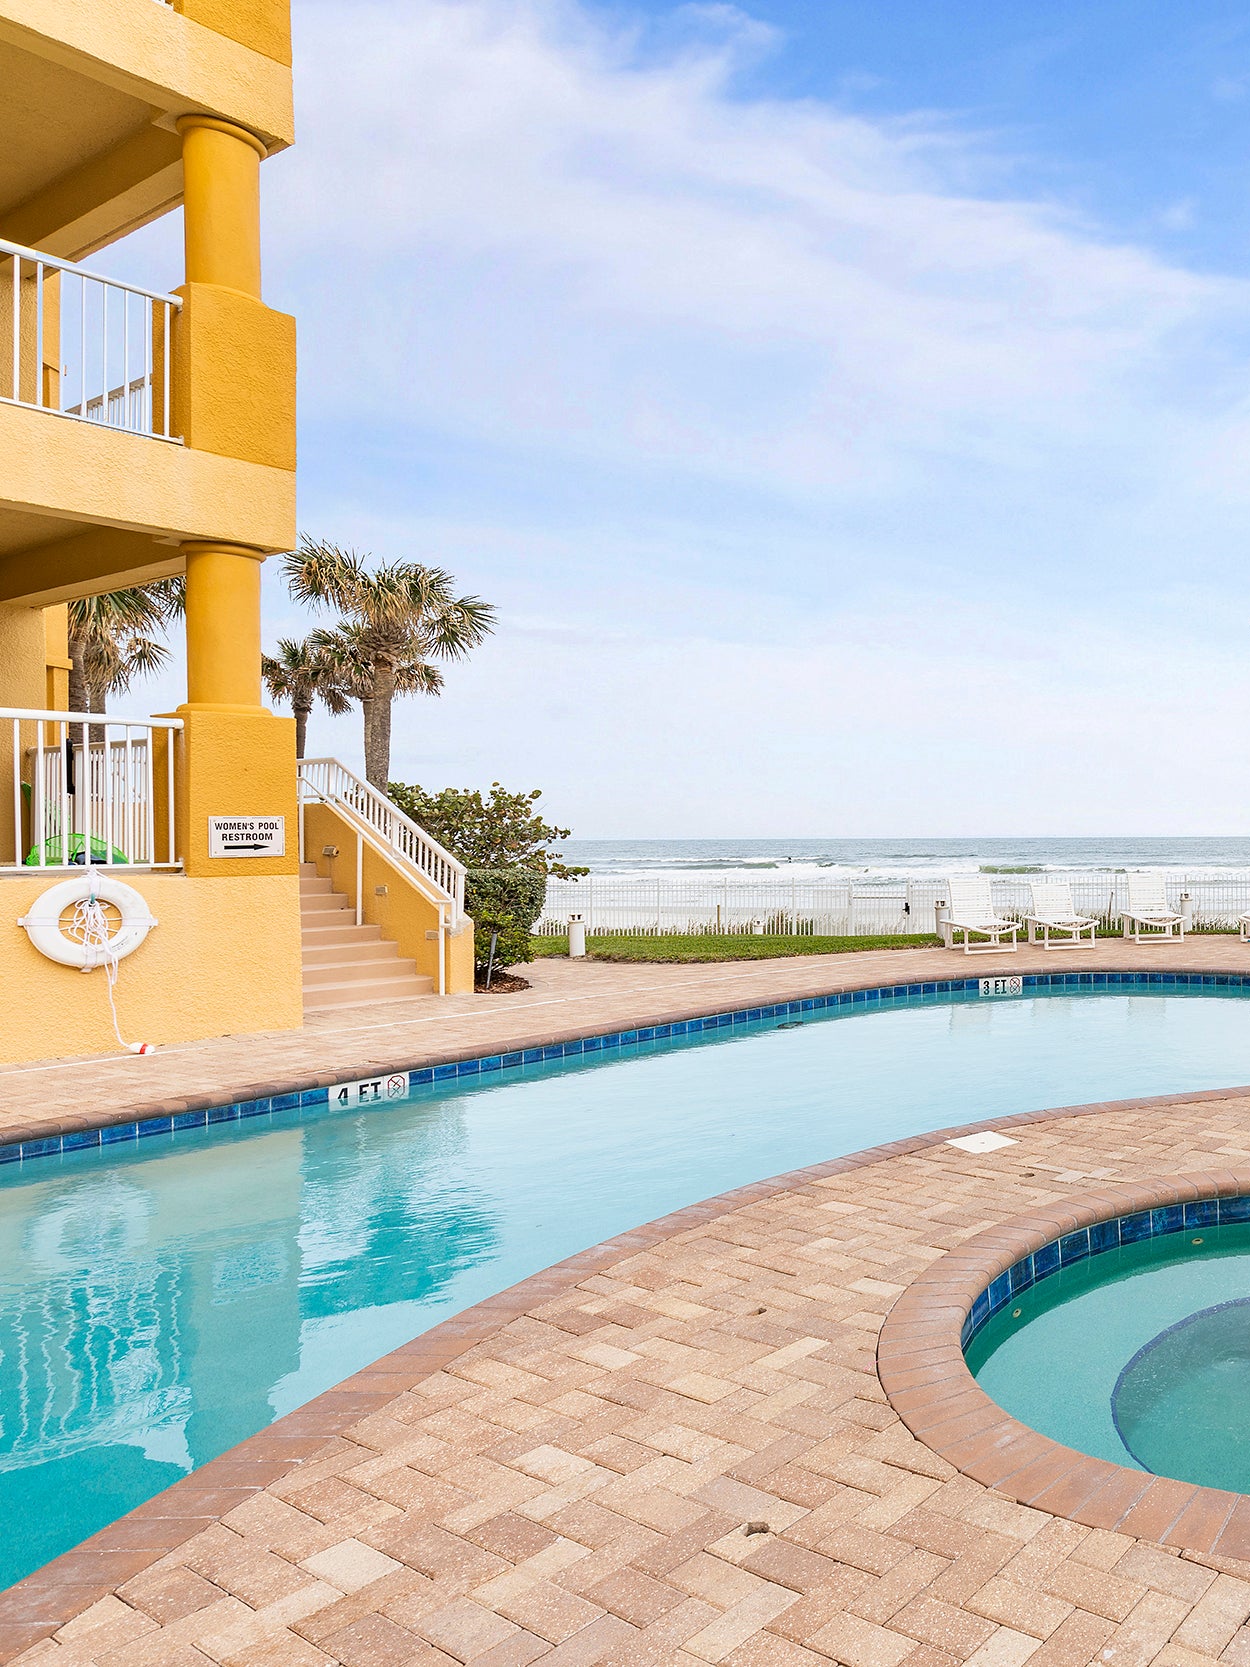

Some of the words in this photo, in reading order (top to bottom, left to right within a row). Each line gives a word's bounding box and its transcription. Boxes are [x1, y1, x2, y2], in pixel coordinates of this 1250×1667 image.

[214, 822, 255, 831] WOMEN'S
[258, 822, 279, 830] POOL
[221, 833, 273, 841] RESTROOM
[337, 1087, 349, 1103] 4
[358, 1081, 382, 1101] FT
